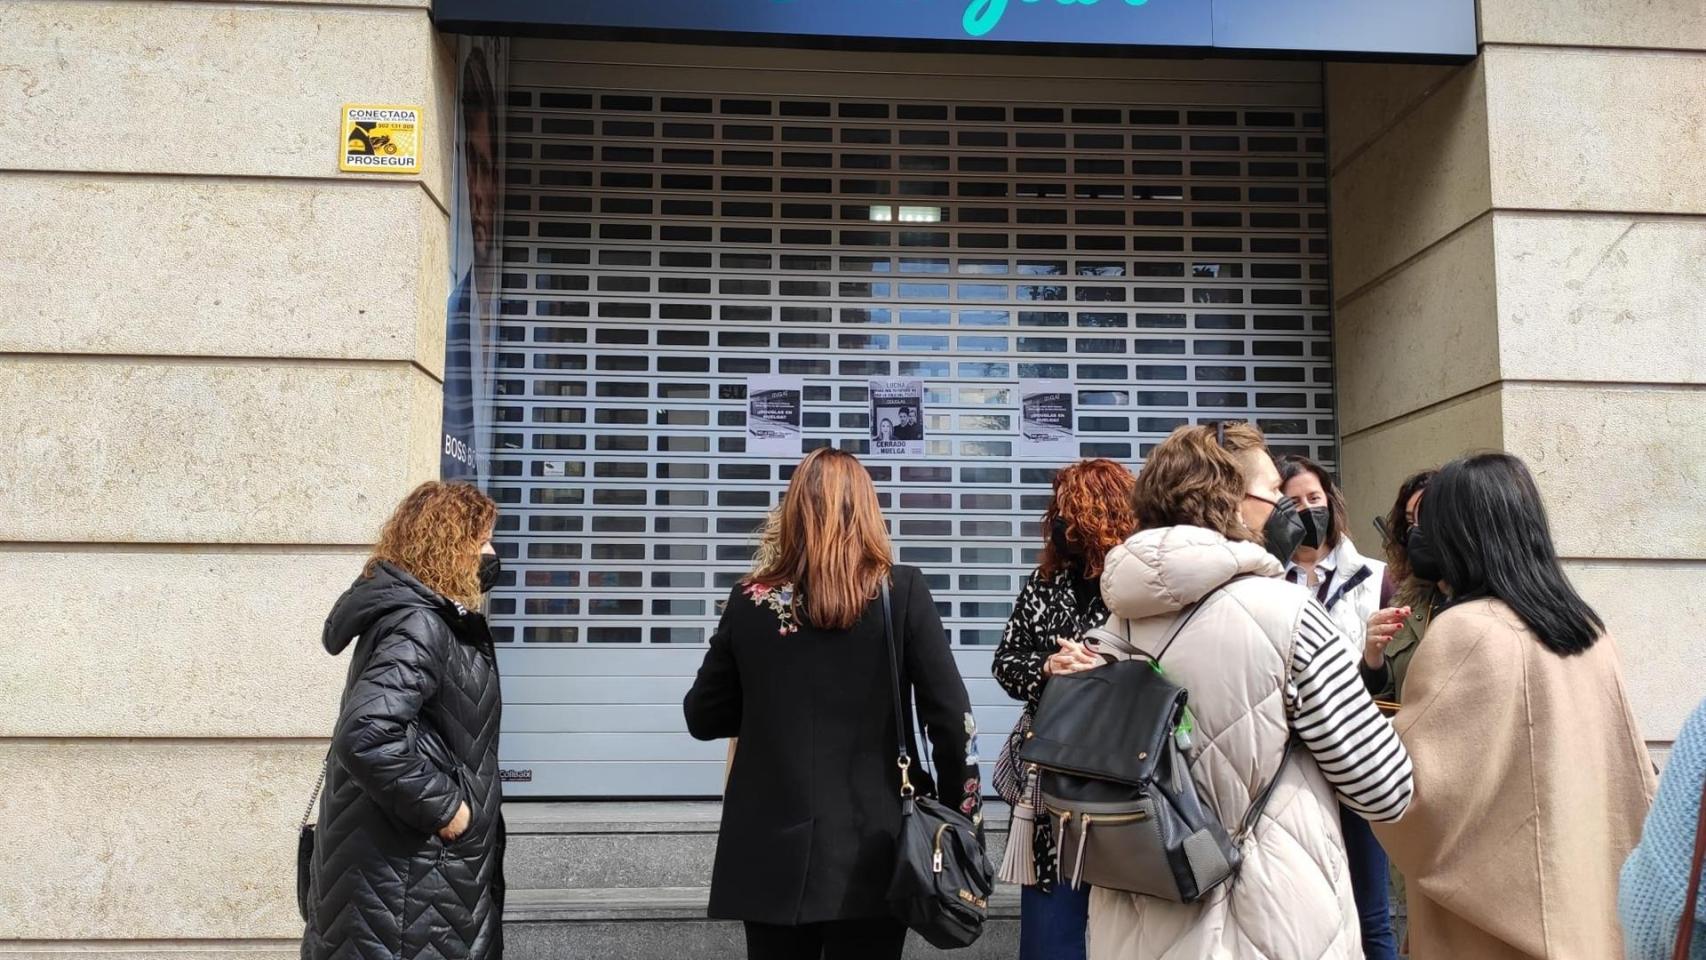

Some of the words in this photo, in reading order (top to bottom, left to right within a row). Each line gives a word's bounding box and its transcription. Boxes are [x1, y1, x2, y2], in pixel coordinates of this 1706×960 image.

[349, 109, 416, 119] CONECTADA
[347, 156, 415, 166] PROSEGUR
[445, 433, 467, 463] BOSS
